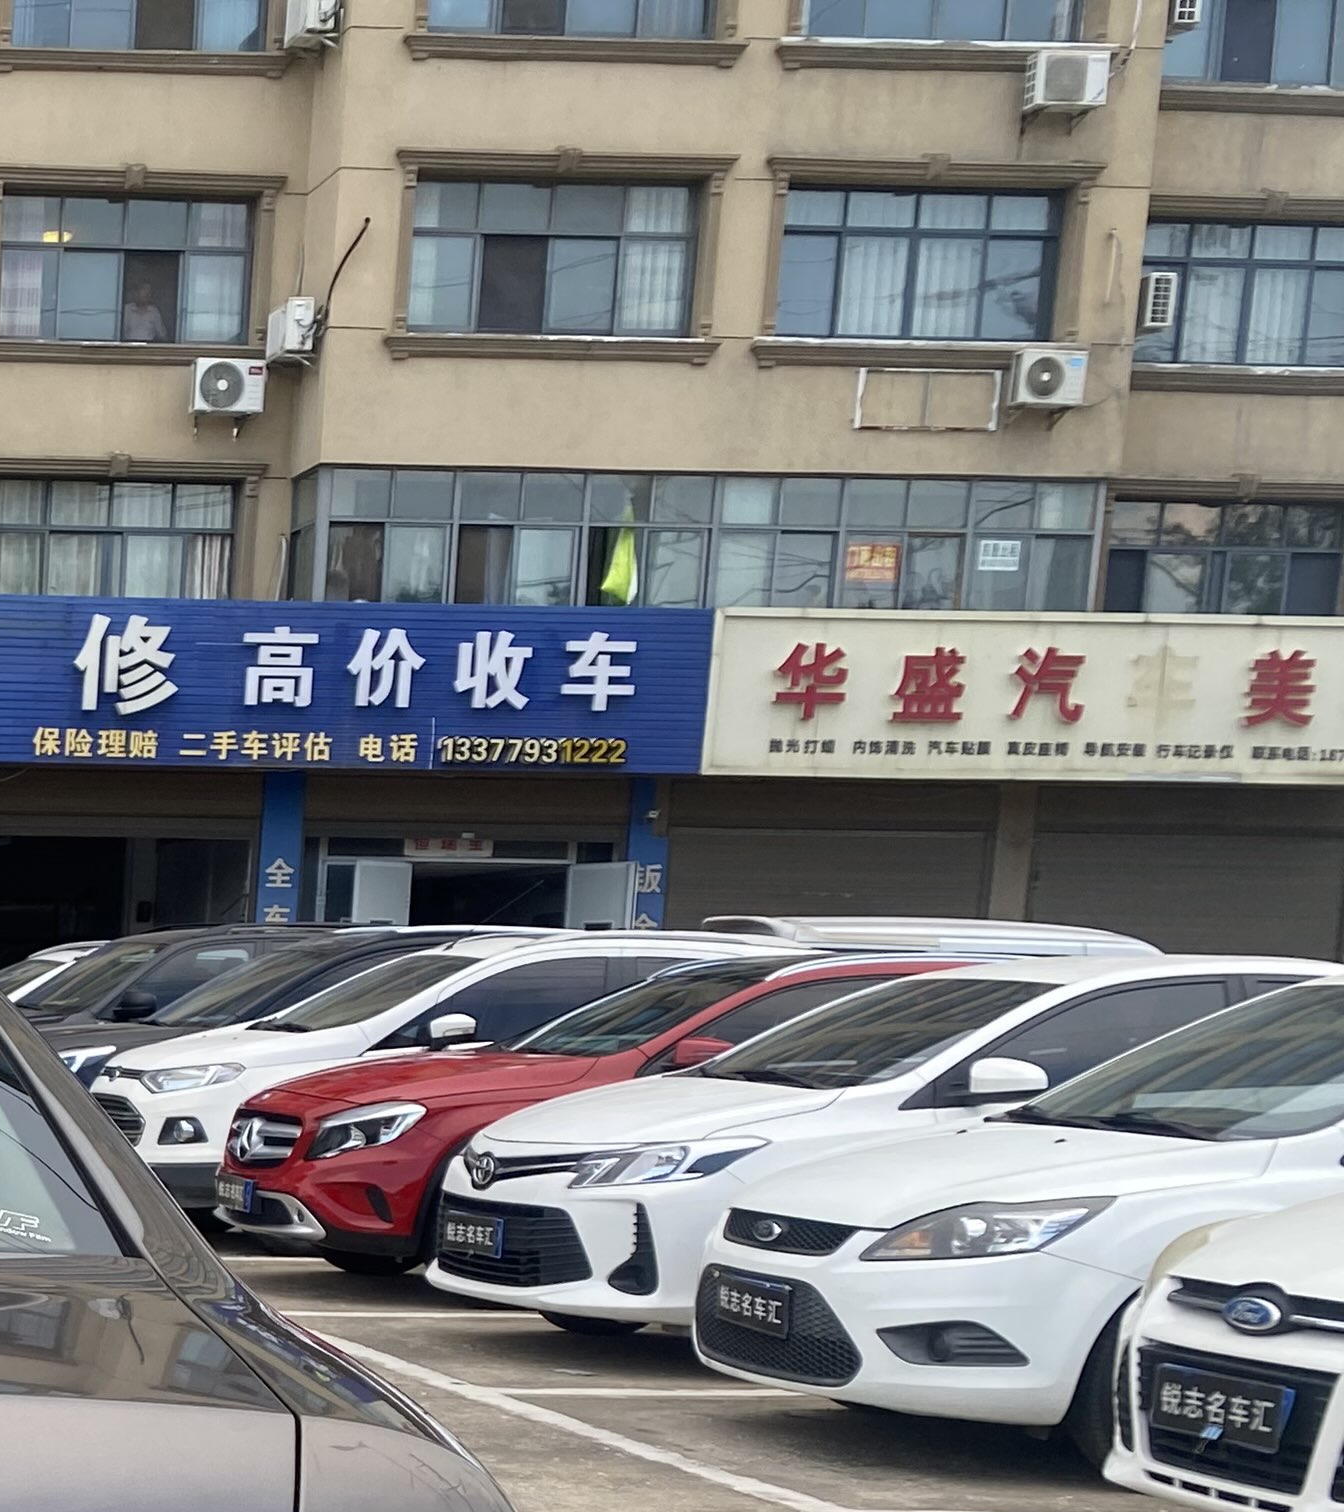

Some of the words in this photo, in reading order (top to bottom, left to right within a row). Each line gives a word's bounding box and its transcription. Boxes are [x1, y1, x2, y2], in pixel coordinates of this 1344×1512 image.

[242, 626, 638, 711] 高价收车
[32, 726, 159, 759] 保险理赔
[179, 730, 333, 762] 二手车评估
[358, 733, 419, 763] 电话
[438, 735, 628, 764] 13377931222
[1159, 1381, 1276, 1434] 锐志名车汇
